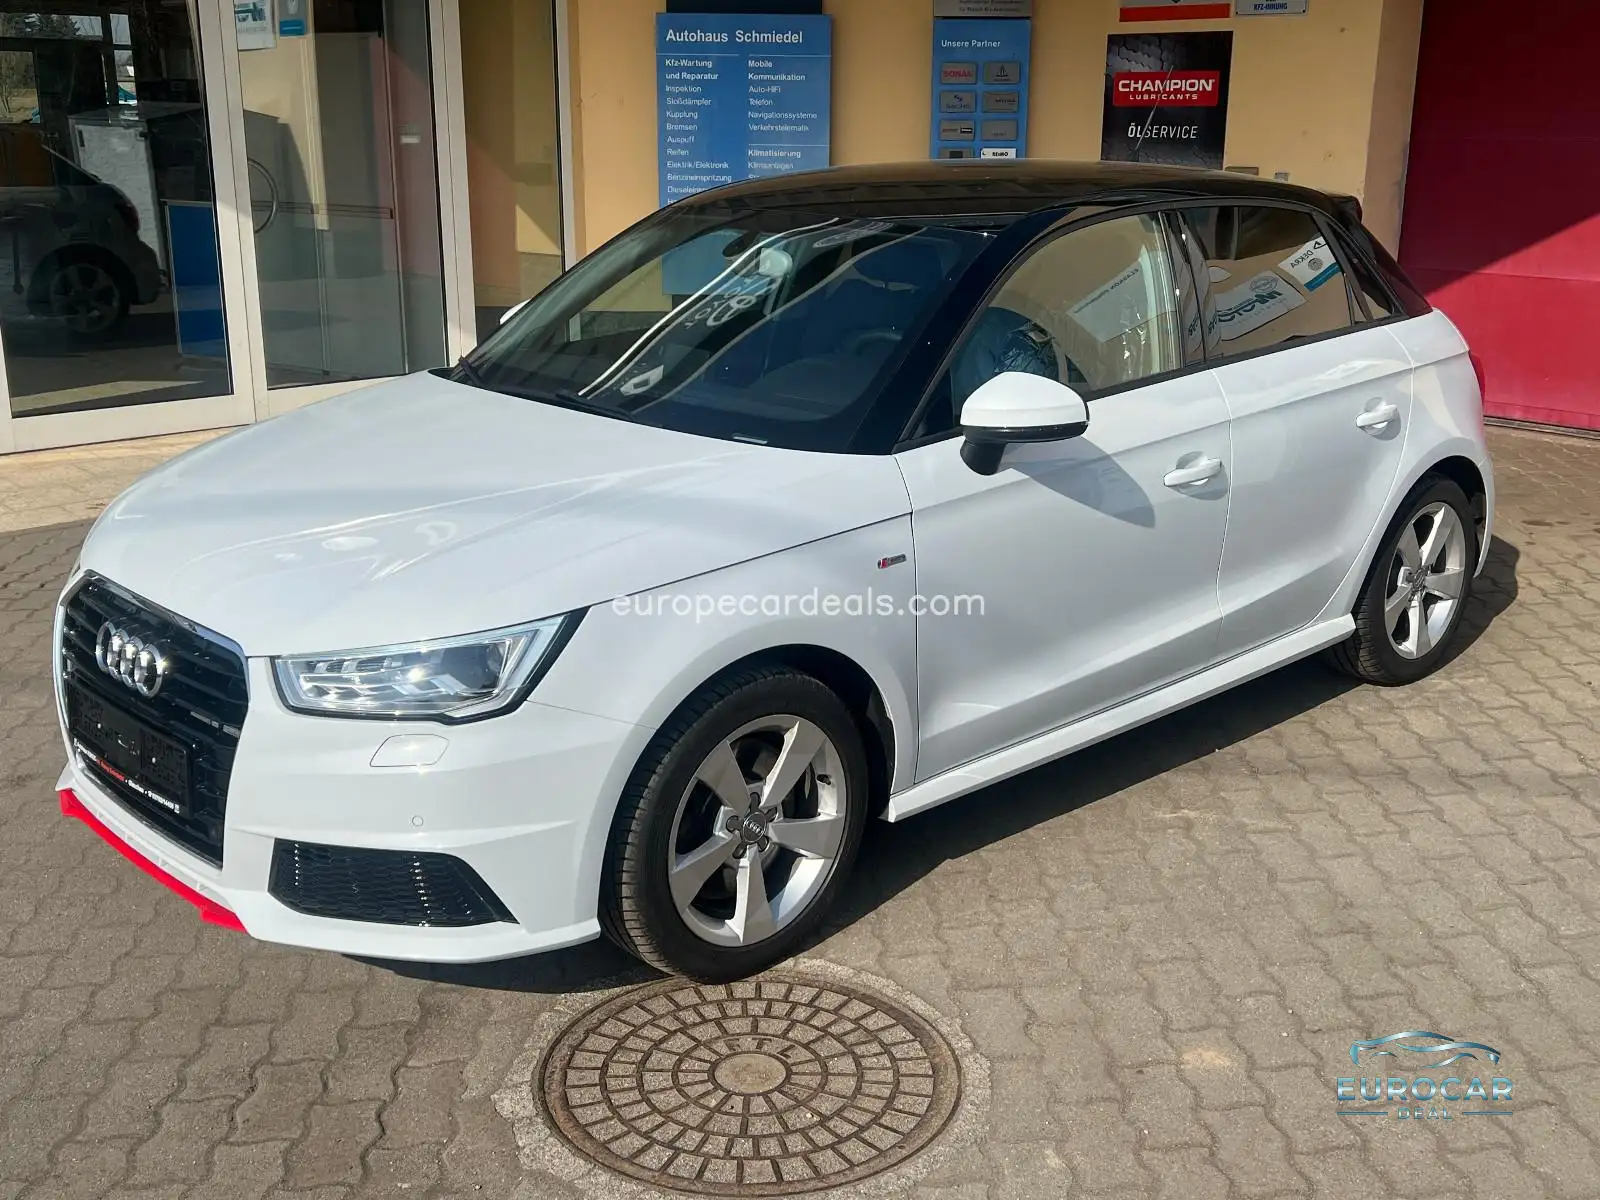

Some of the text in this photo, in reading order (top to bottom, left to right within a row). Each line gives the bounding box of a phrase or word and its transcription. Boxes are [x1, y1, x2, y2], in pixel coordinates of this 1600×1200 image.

[665, 29, 803, 44] Autohaus Schmiedel
[941, 40, 1001, 48] Unsere Partner
[665, 59, 713, 69] Kfz-Wartung
[748, 60, 773, 68] Mobile
[665, 72, 719, 82] und Reparatur
[748, 73, 806, 81] Kommunikation
[665, 85, 702, 94] Inspektion
[1118, 79, 1215, 92] CHAMPION
[666, 97, 712, 107] Stoßdämpfer
[748, 98, 773, 106] Telefon
[665, 110, 699, 120] Kupplung
[748, 111, 818, 121] Navigationssysteme
[666, 123, 698, 131] Bremsen
[748, 124, 809, 132] Verkehrstelematik
[667, 135, 695, 144] Auspuff
[666, 148, 690, 156] Reifen
[748, 149, 801, 158] Klimatisierung
[667, 161, 730, 169] Elektrik/Elektronik
[667, 173, 732, 183] Benzineinspritzung
